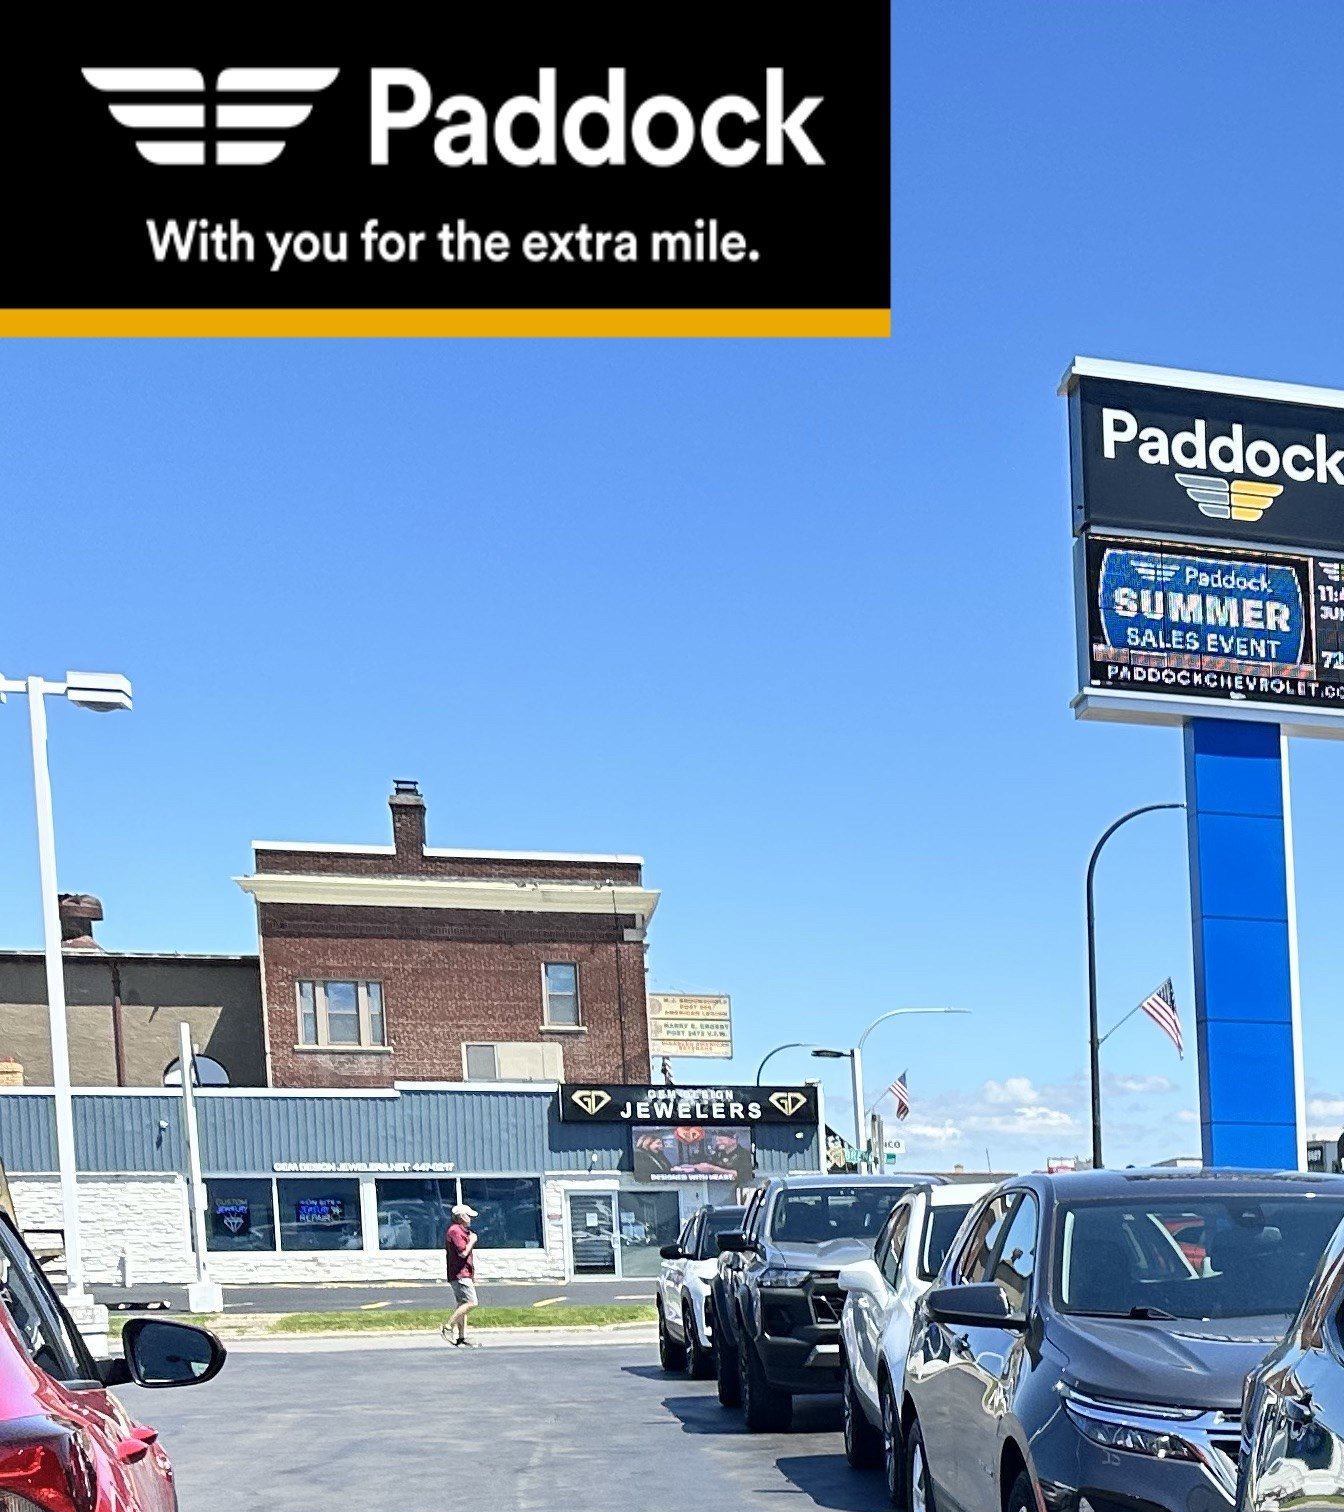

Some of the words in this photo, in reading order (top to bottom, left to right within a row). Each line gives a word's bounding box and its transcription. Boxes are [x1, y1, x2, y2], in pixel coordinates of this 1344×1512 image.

[1185, 566, 1272, 593] Paddock
[1114, 586, 1291, 632] SUMMER
[1127, 626, 1200, 651] SALES
[1207, 632, 1282, 659] EVENT
[620, 1101, 762, 1120] JEWELERS
